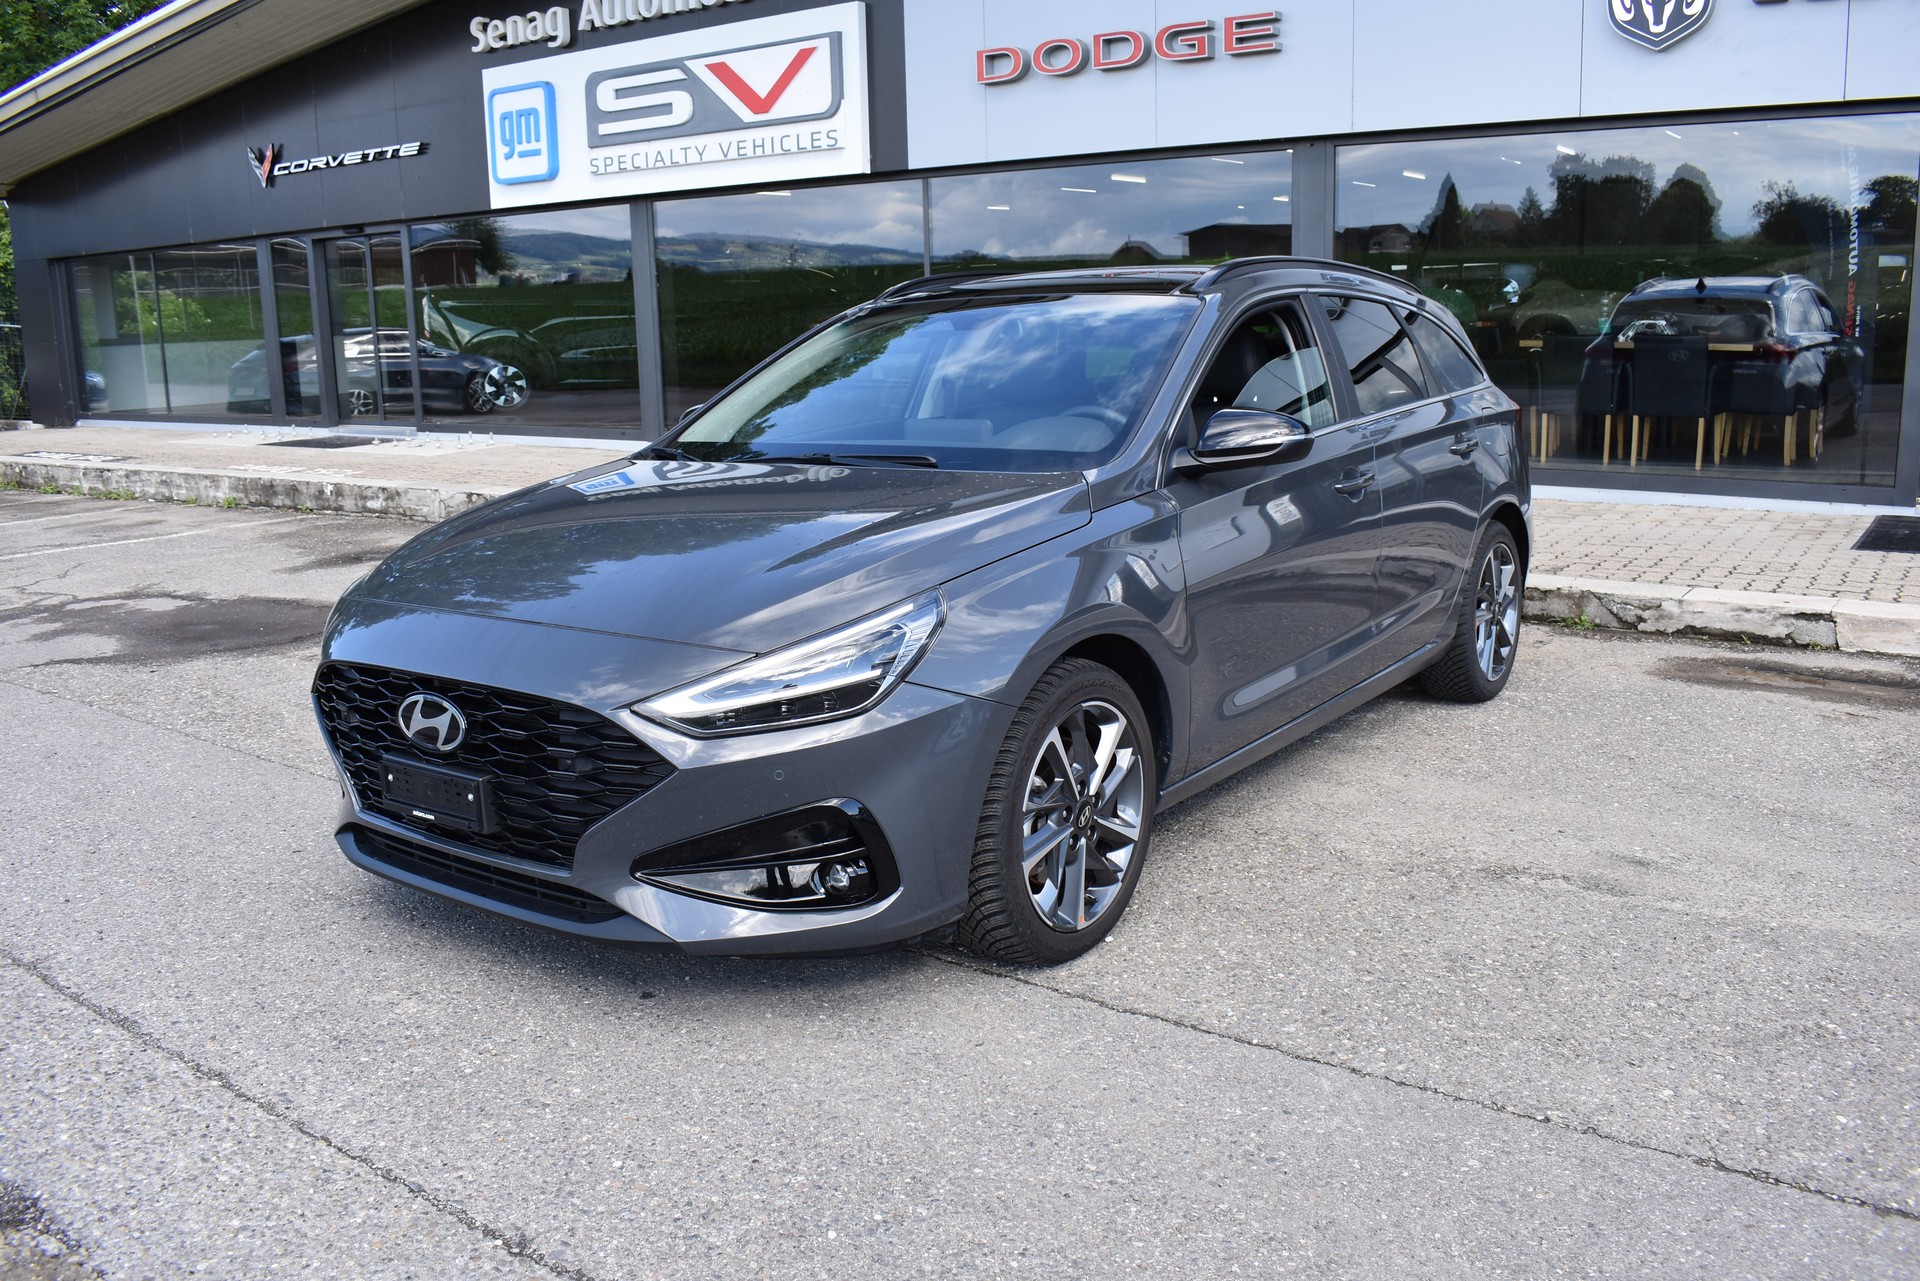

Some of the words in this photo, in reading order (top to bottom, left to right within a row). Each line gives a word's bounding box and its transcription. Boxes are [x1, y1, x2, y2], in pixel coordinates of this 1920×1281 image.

[469, 6, 571, 53] Senag
[976, 10, 1283, 85] DODGE
[499, 107, 542, 160] gm
[590, 145, 707, 174] SPECIALTY
[719, 129, 839, 158] VEHICLES
[273, 141, 421, 176] CORVETTE
